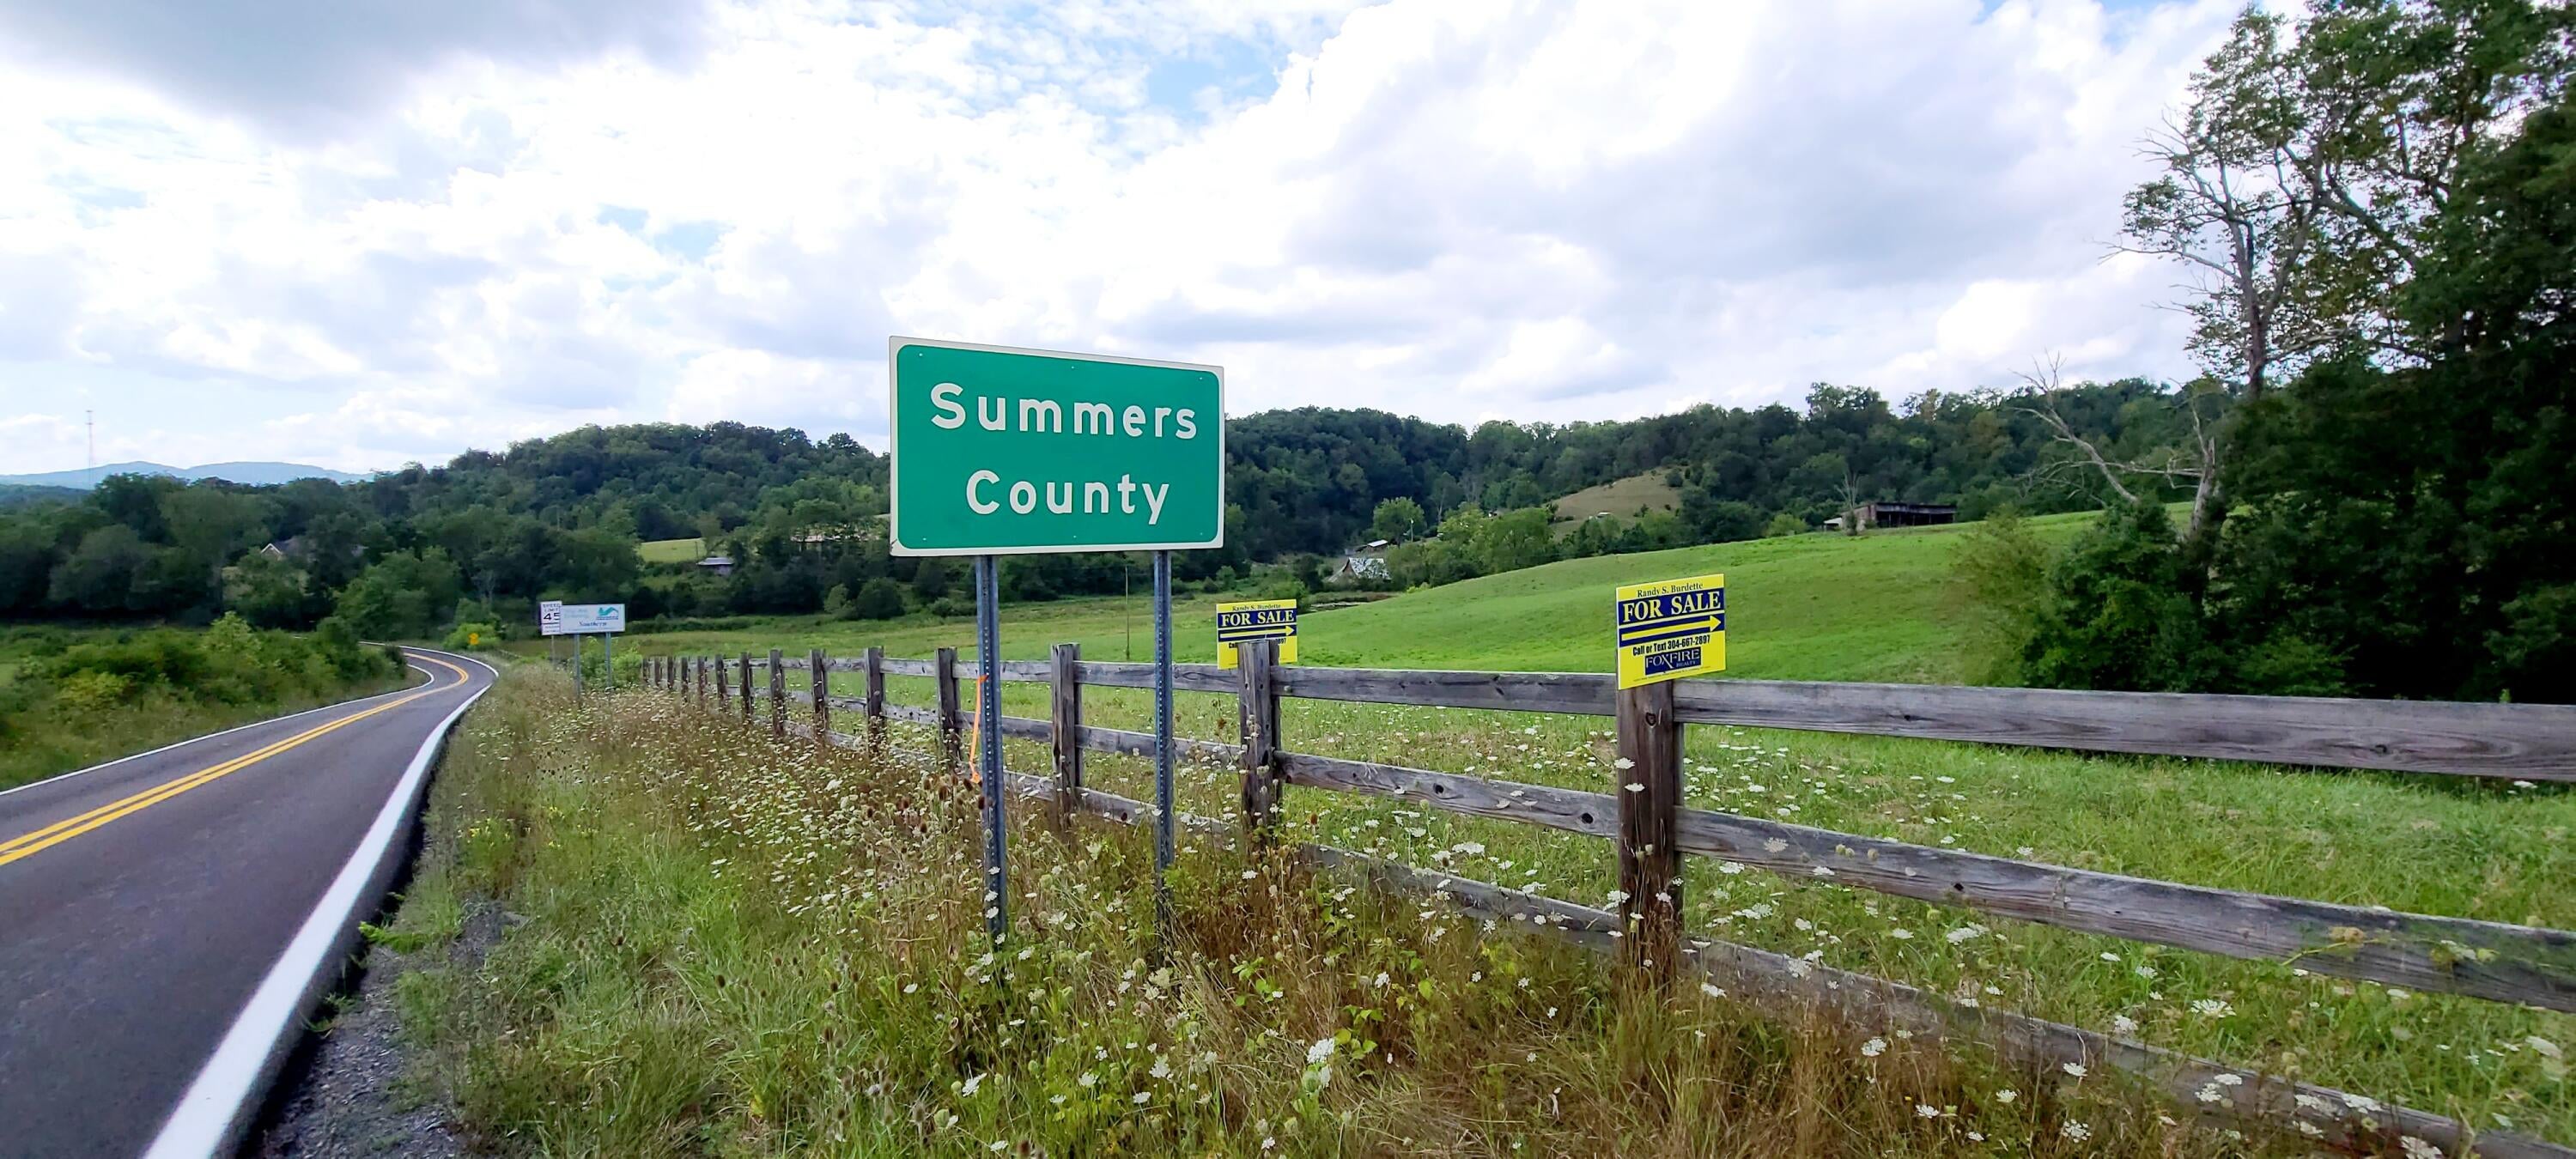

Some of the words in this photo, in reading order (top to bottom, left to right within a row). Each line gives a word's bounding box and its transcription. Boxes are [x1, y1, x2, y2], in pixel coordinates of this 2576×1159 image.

[930, 382, 1197, 440] Summers
[966, 470, 1170, 525] County
[1637, 587, 1660, 598] Randy
[1662, 586, 1669, 594] S.
[1671, 582, 1704, 593] Burdette
[543, 612, 561, 621] 45
[1622, 599, 1663, 622] FOR
[1671, 591, 1721, 615] SALE
[1221, 612, 1252, 627] FOR
[1257, 610, 1295, 624] SALE
[1632, 645, 1645, 656] Call
[1646, 645, 1653, 653] or
[1654, 642, 1667, 652] Text
[1668, 634, 1710, 650] 304-667-2897
[1645, 649, 1700, 669] FOXFIRE
